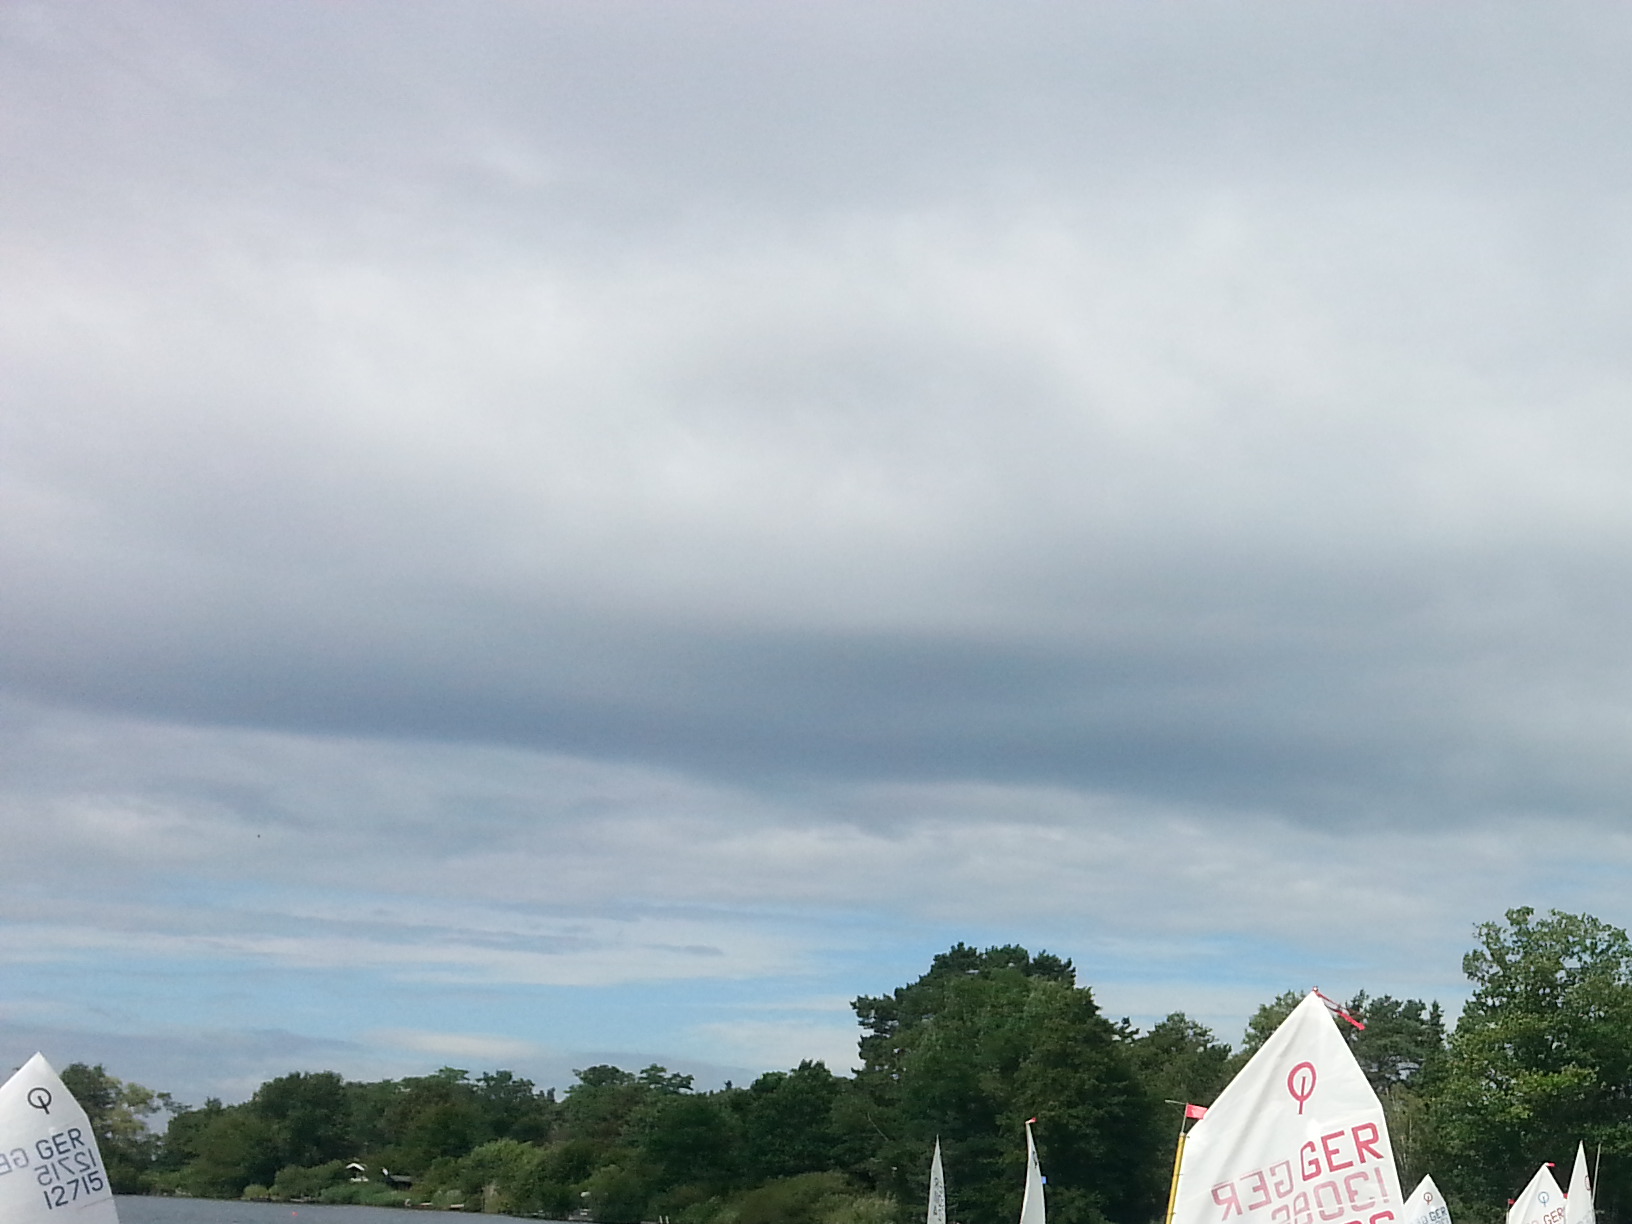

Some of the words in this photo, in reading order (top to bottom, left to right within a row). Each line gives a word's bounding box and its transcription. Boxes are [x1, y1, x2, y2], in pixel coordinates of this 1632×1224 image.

[36, 1128, 85, 1160] GER
[1300, 1122, 1385, 1181] GER
[44, 1171, 104, 1210] 12715
[1429, 1206, 1447, 1221] GER
